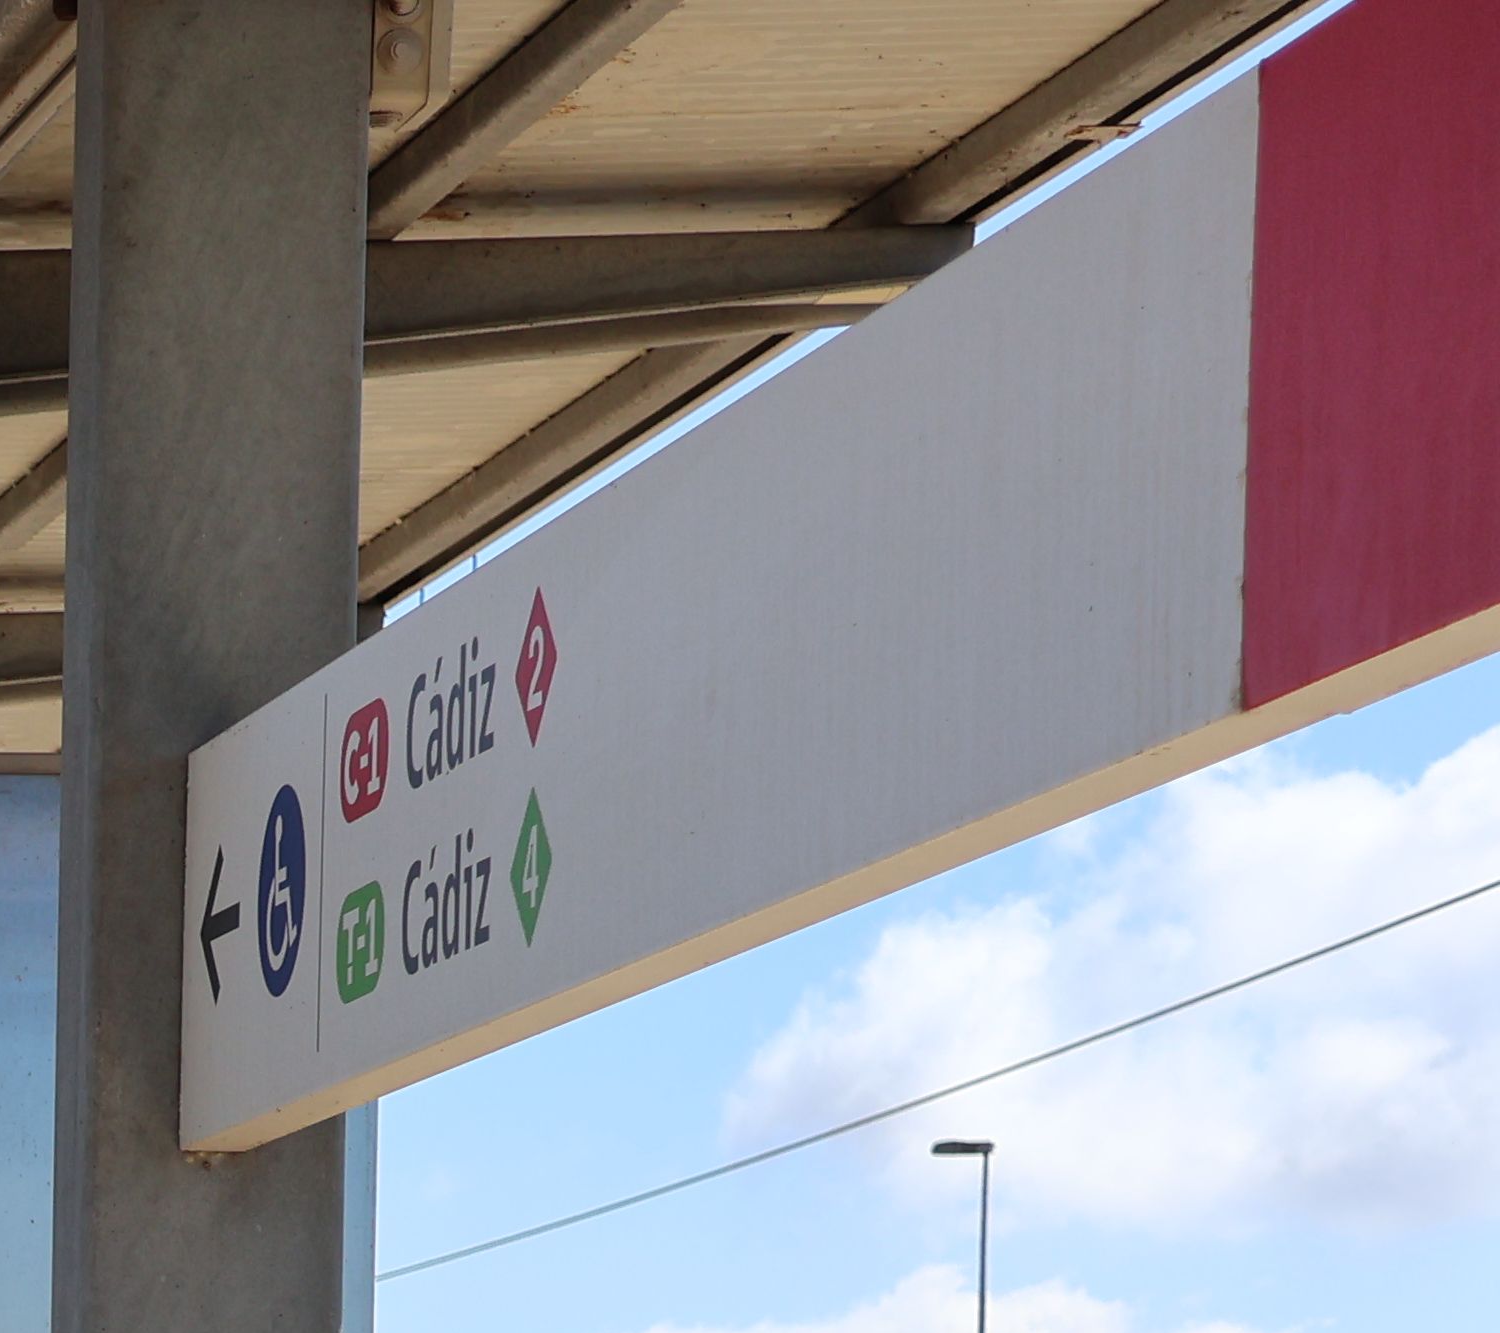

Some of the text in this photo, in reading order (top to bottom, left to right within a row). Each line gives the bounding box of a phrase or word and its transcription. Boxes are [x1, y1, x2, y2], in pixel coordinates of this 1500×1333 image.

[343, 624, 545, 806] C-1 Cádiz 2
[342, 823, 540, 985] T-1 Cádiz 4
